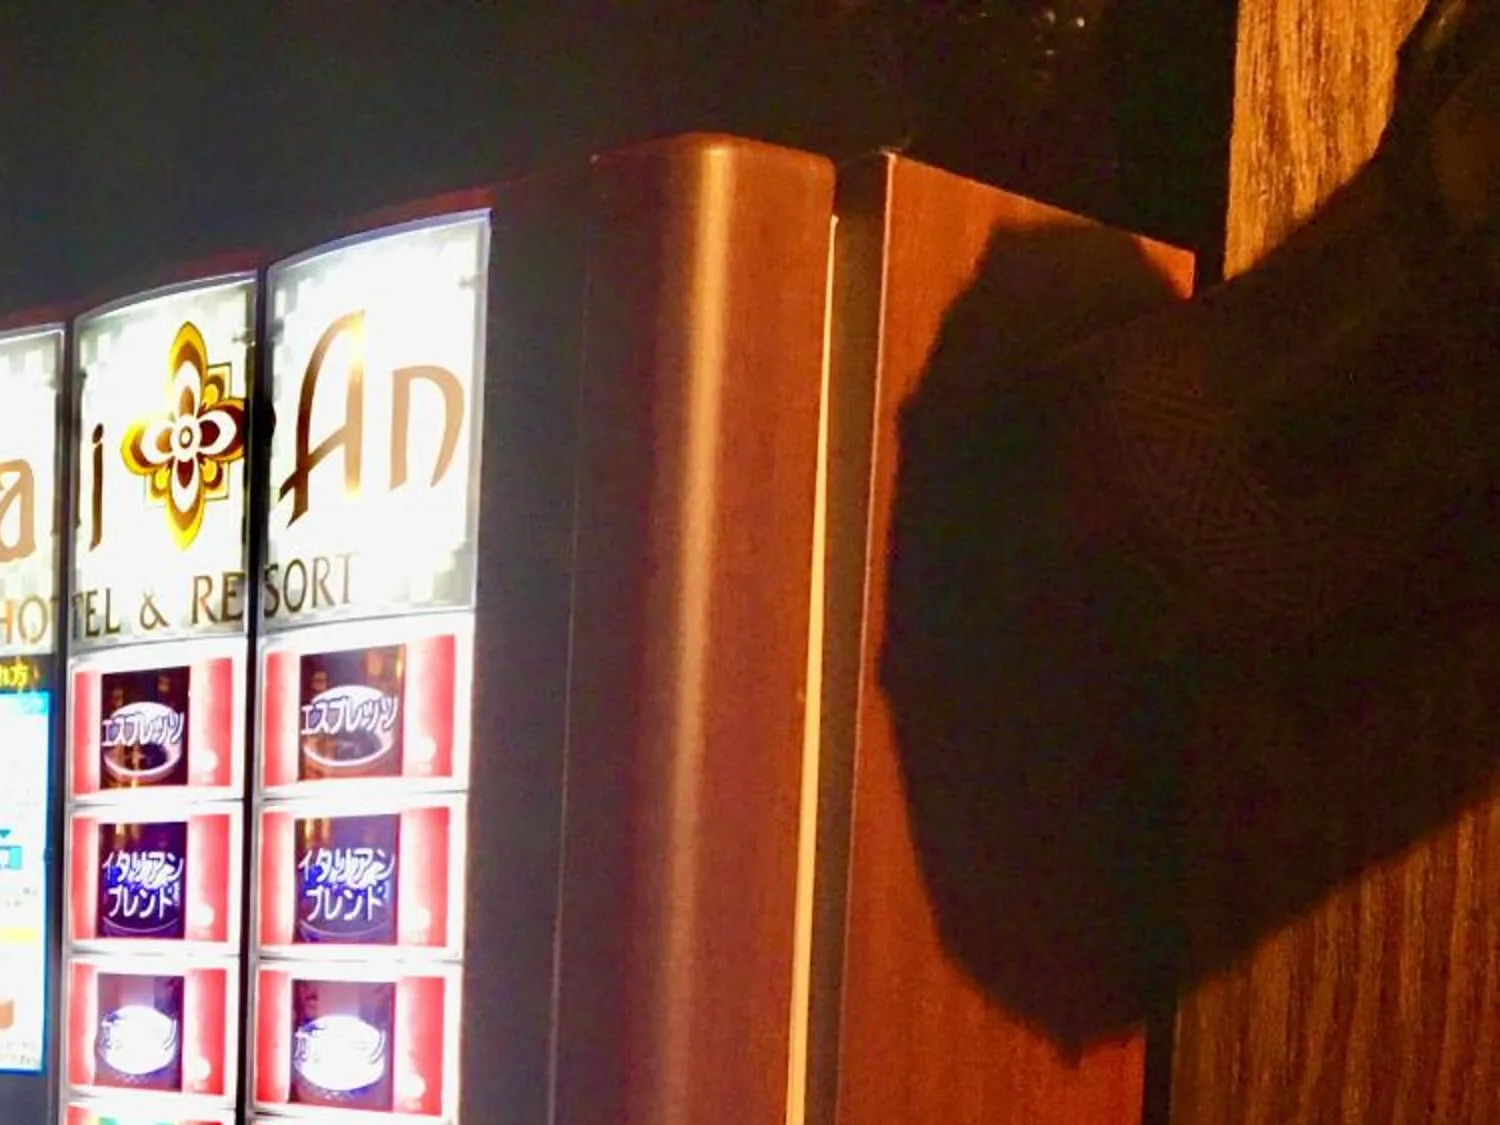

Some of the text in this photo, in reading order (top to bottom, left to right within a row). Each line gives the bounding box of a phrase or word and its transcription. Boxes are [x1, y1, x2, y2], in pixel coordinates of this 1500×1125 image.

[280, 310, 465, 528] An
[139, 590, 168, 630] &
[190, 551, 357, 627] RESORT
[108, 883, 180, 920] ブレンド
[305, 883, 390, 922] ブレンド
